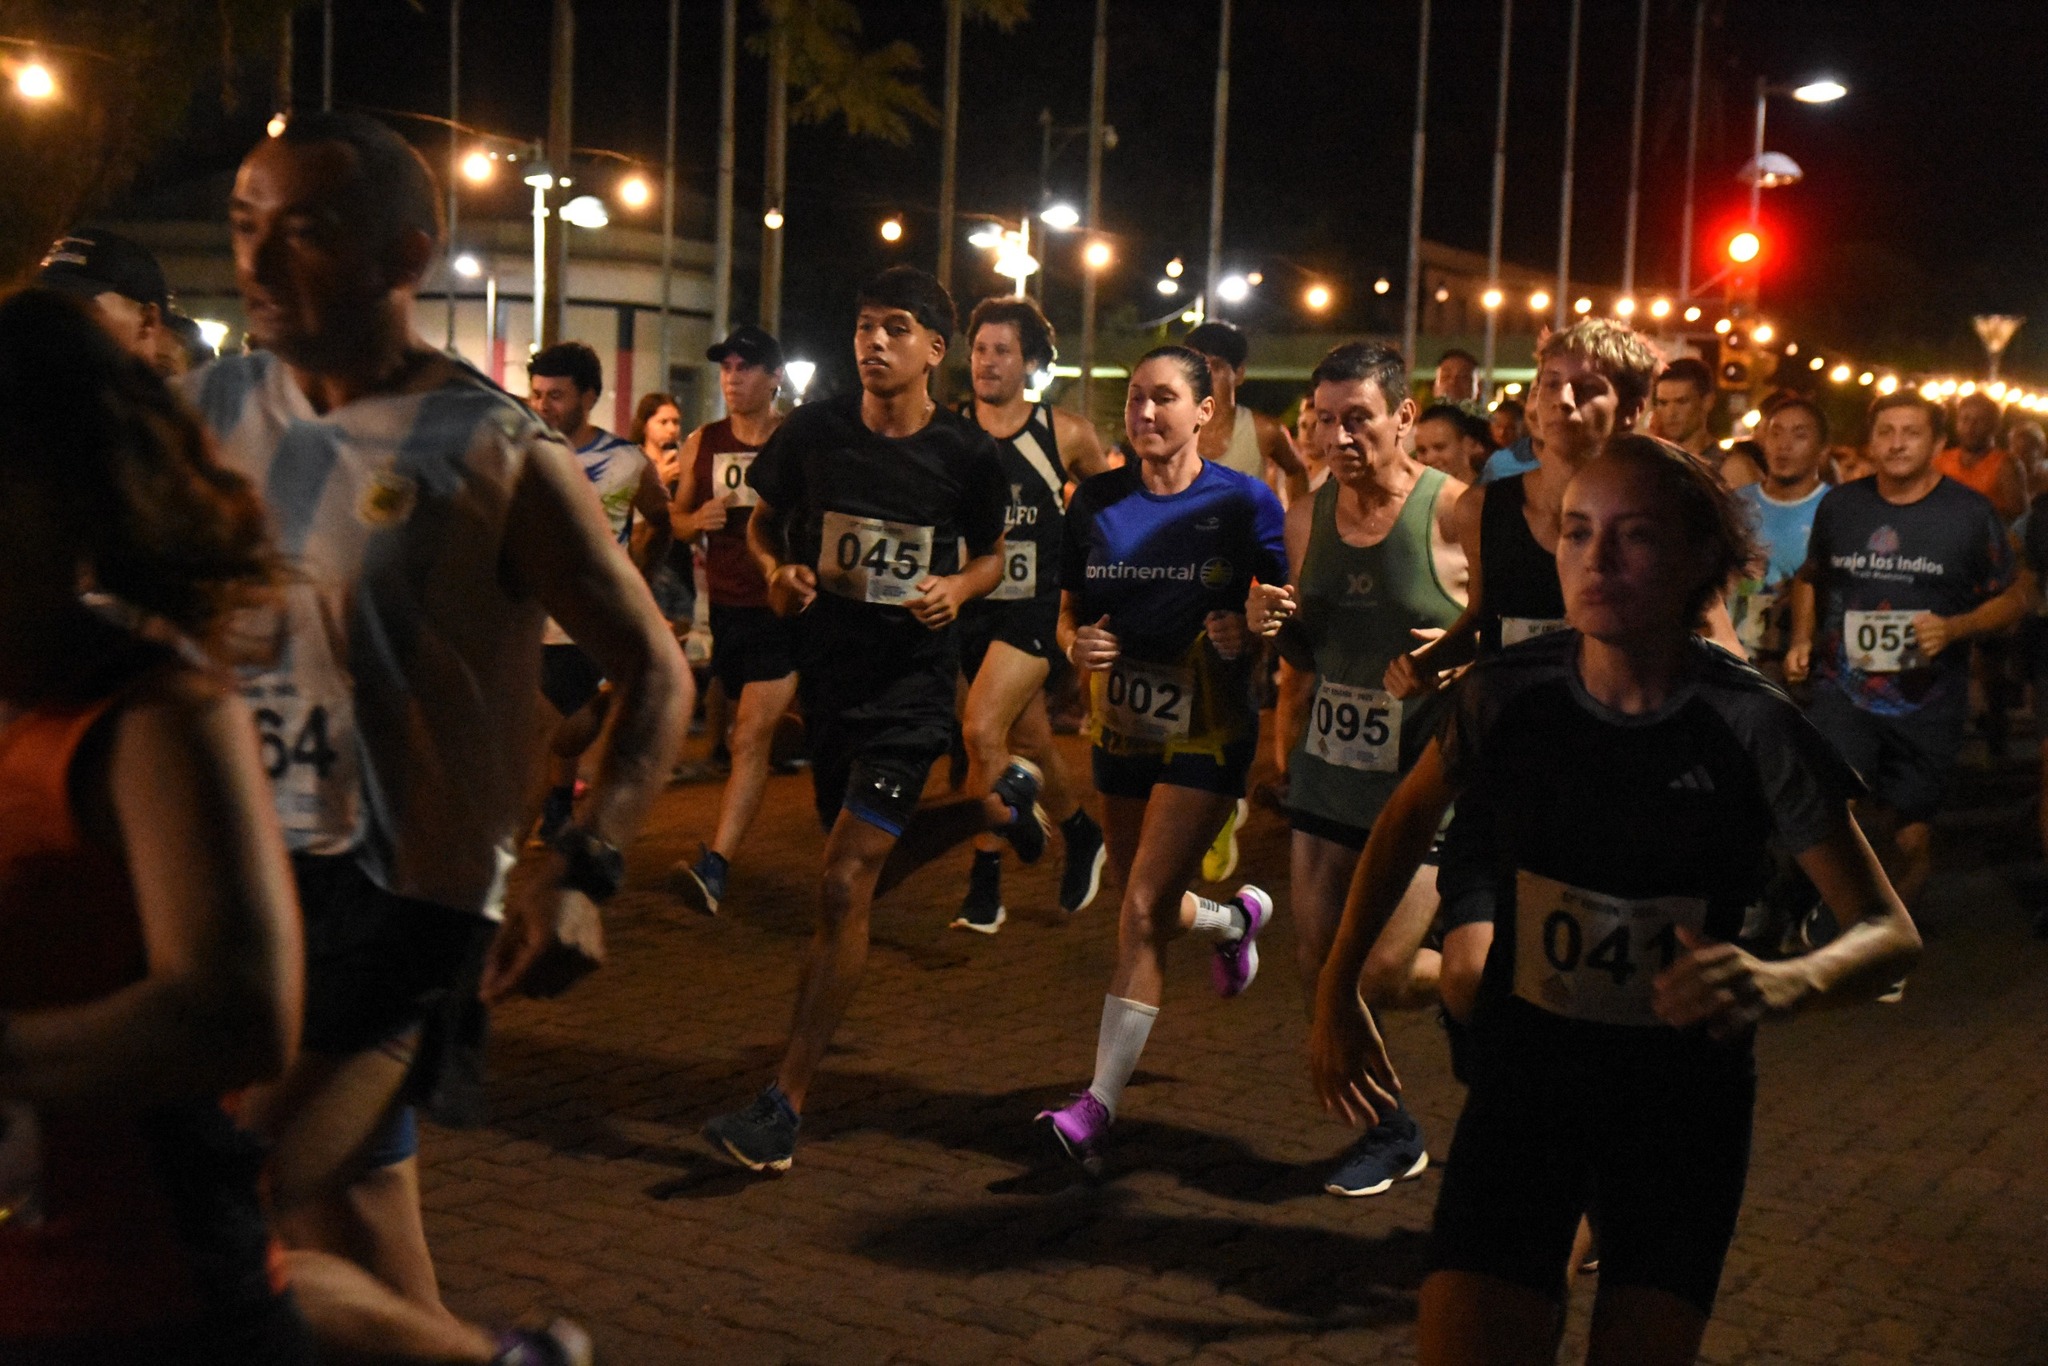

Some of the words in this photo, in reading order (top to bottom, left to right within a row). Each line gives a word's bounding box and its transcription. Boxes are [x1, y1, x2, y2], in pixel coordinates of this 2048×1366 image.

[837, 532, 920, 580] 045
[1002, 553, 1029, 582] 6
[1107, 668, 1182, 722] 002
[1317, 697, 1390, 746] 095
[1543, 910, 1676, 986] 041
